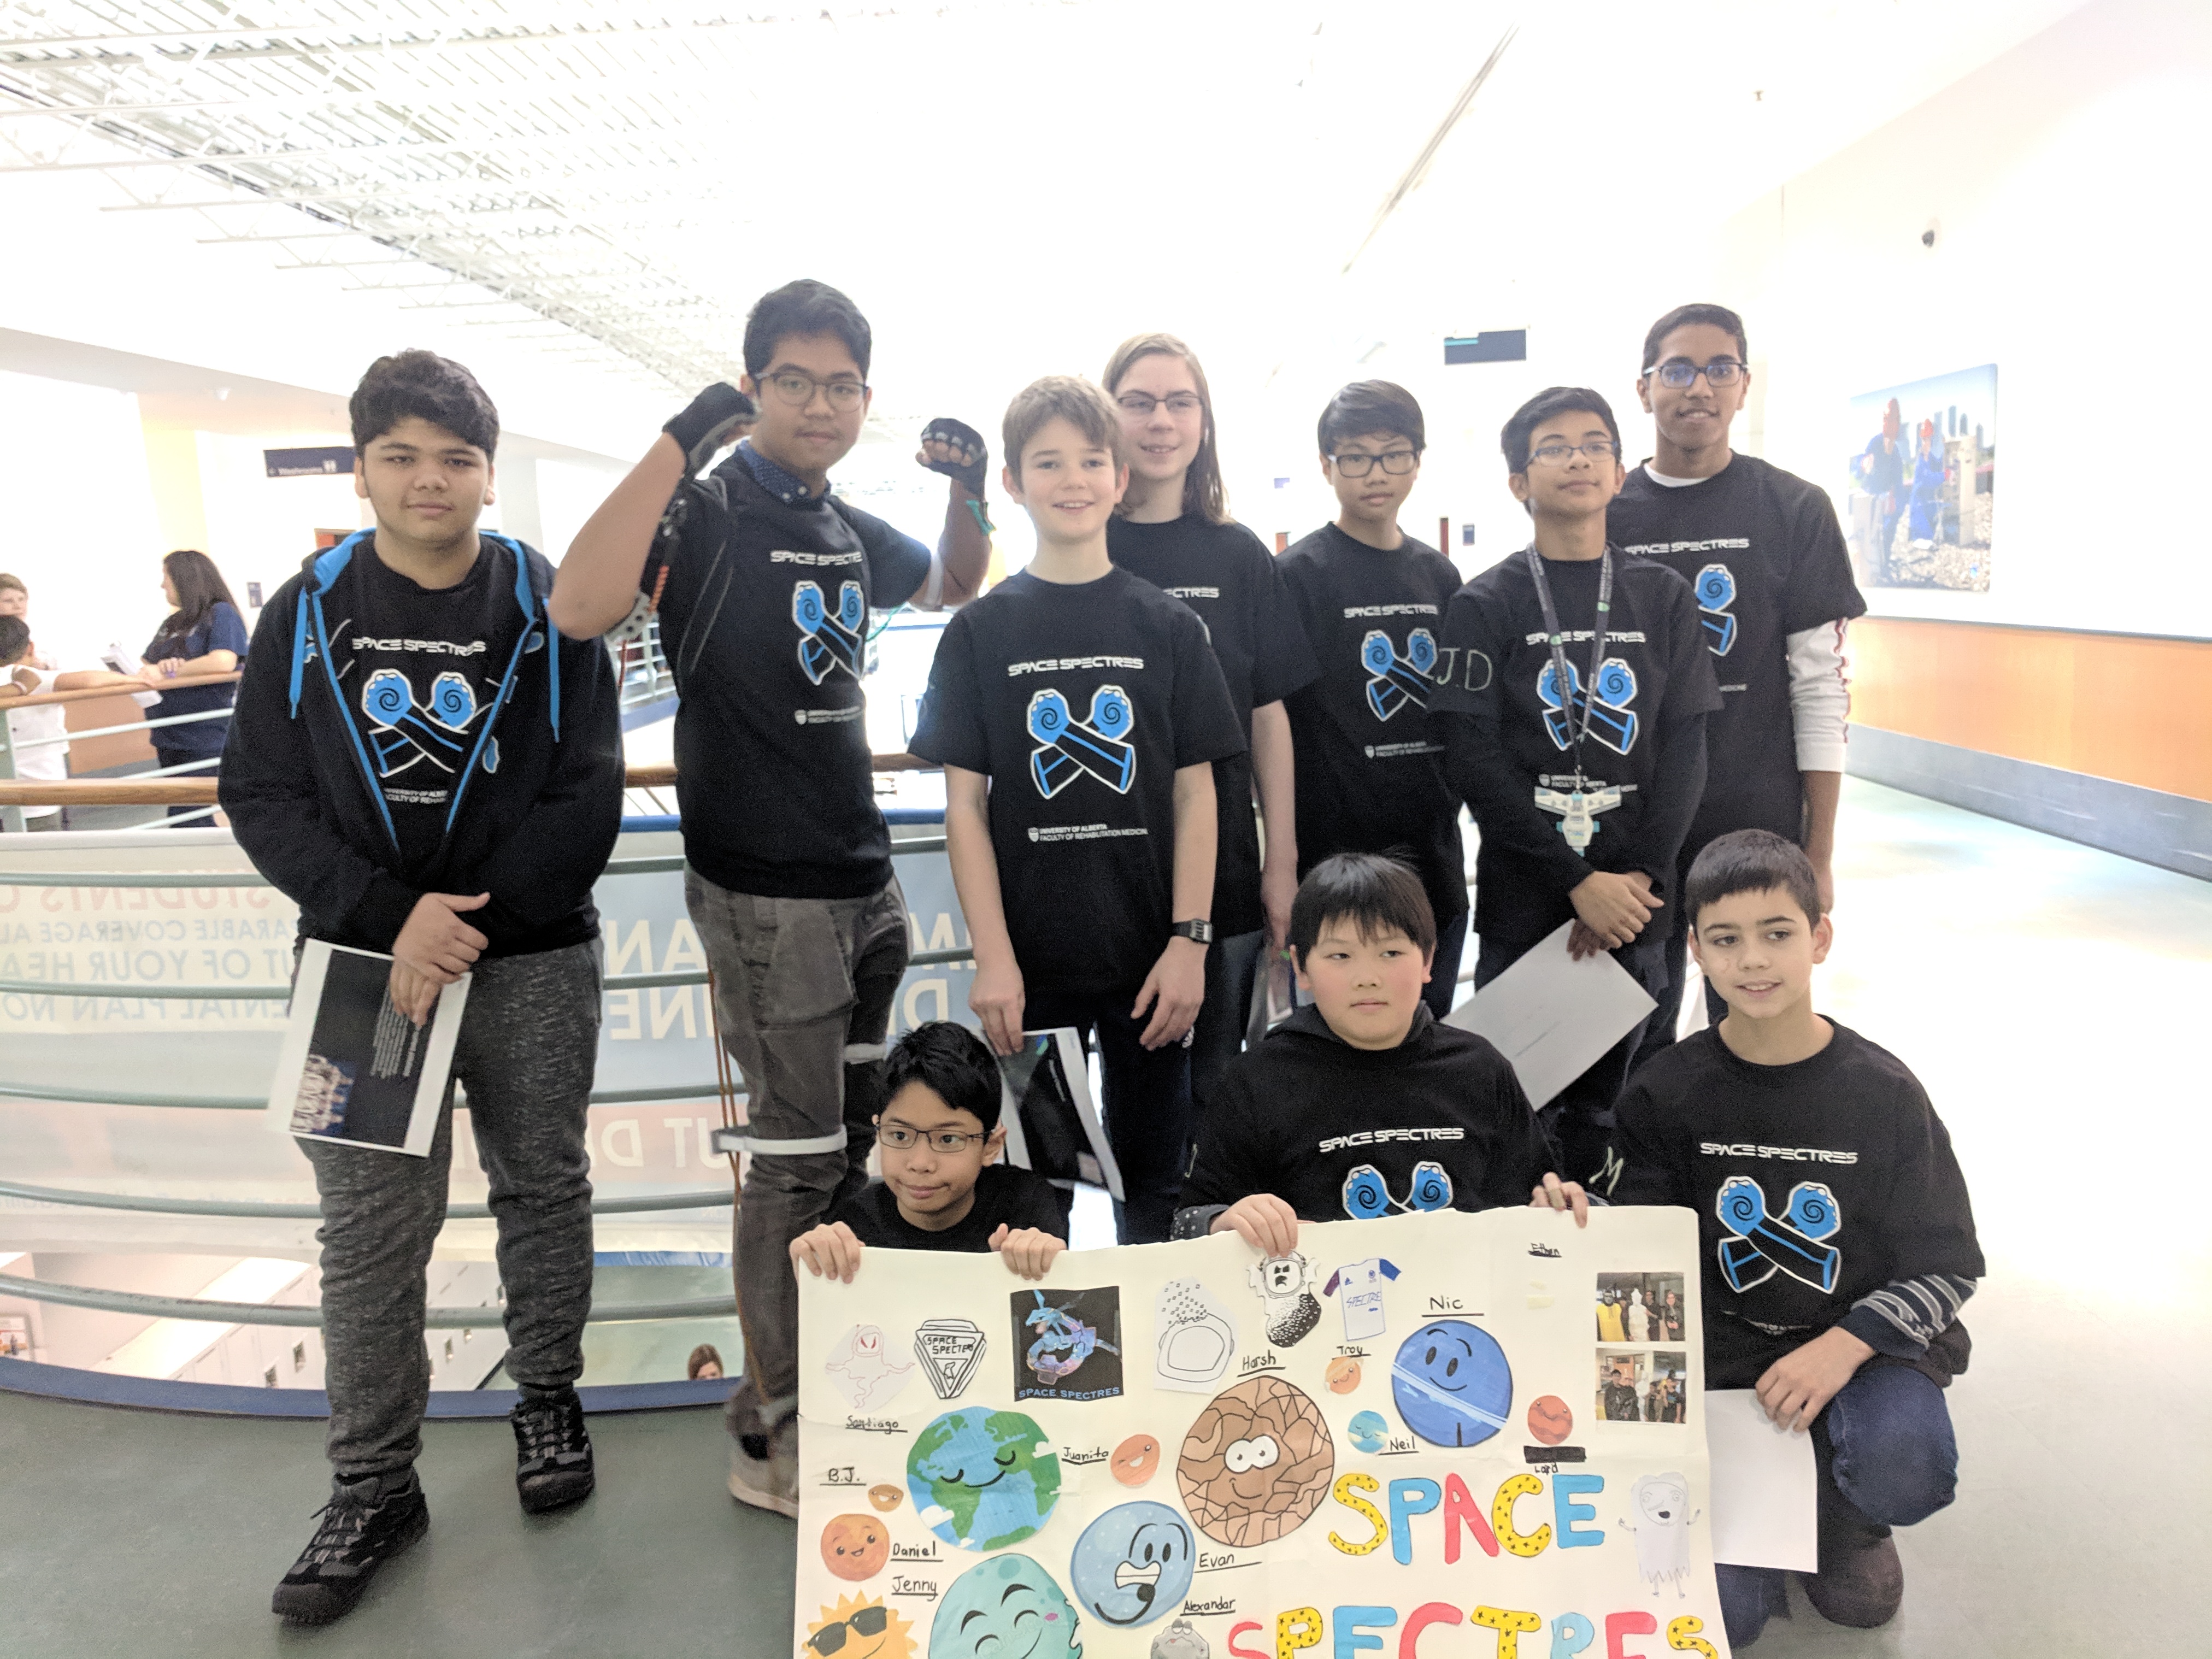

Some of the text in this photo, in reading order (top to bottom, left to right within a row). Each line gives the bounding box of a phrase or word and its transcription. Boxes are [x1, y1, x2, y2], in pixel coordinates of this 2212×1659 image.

[1670, 538, 1750, 552] SPECTRES
[352, 637, 402, 651] SPACE
[1008, 656, 1145, 676] SPACE SPECTRES
[1319, 1127, 1464, 1153] SPACE SPECTRES
[1700, 1143, 1858, 1164] SPACE SPECTRES
[1429, 1295, 1463, 1310] Nic
[927, 1336, 957, 1345] SPACE
[1019, 1386, 1120, 1400] SPACE SPECTRES
[1390, 1435, 1415, 1452] Neil
[828, 1466, 860, 1482] B.J.
[1328, 1473, 1605, 1566] SPACE
[893, 1540, 936, 1557] Daniel
[1199, 1552, 1234, 1568] Evan
[892, 1575, 937, 1602] Jenny
